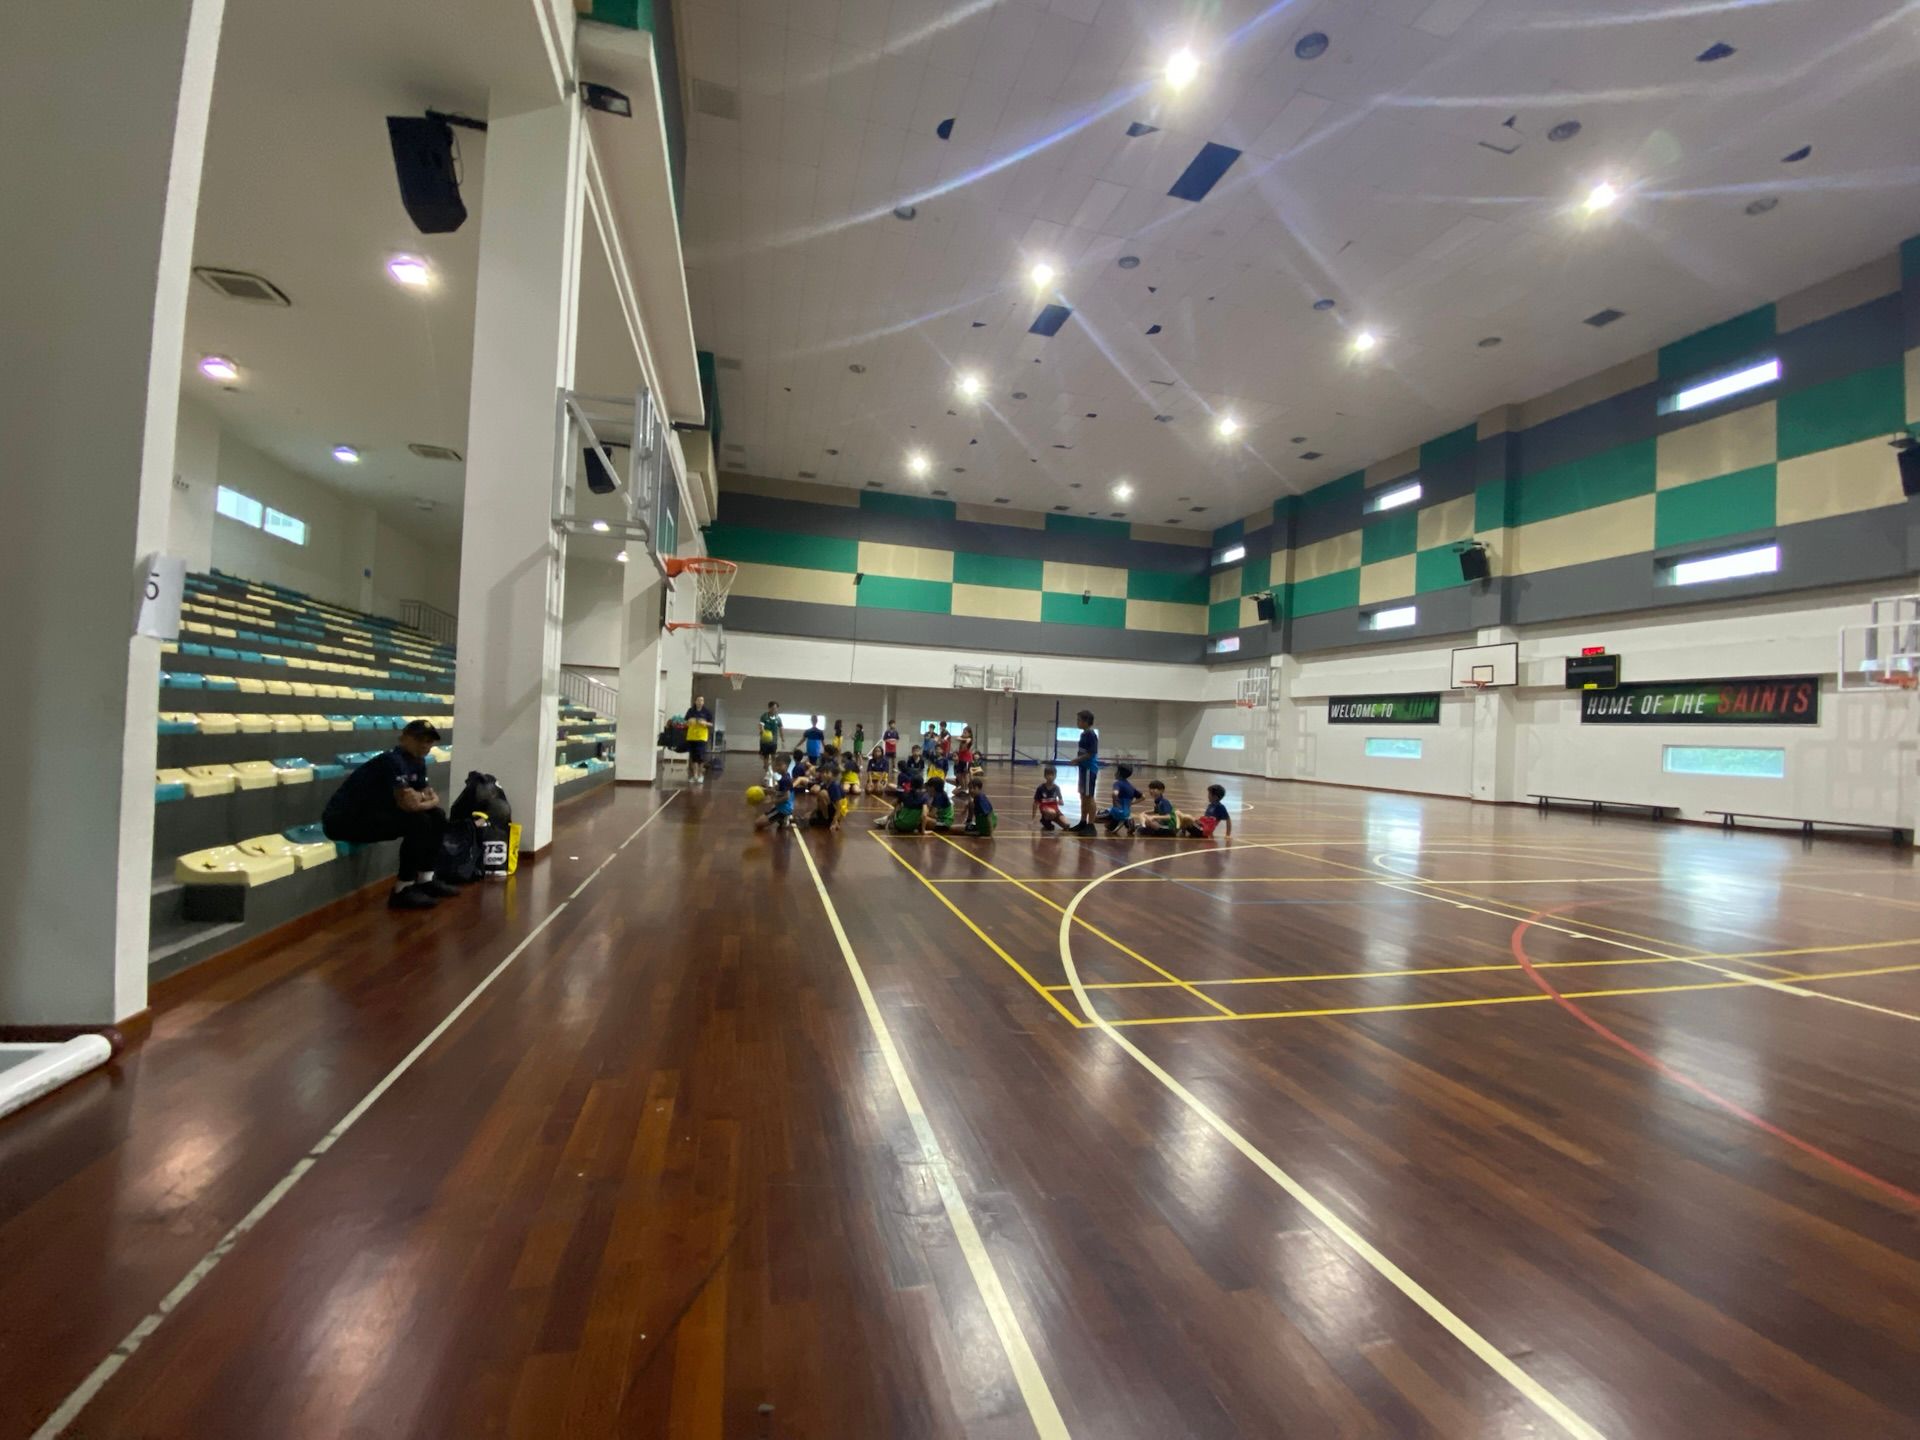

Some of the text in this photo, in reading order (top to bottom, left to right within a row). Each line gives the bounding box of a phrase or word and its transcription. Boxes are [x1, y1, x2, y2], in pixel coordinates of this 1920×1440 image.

[1331, 703, 1377, 718] WELCOME
[1381, 702, 1394, 718] TO
[1587, 683, 1812, 715] HOME OF THE SAINTS
